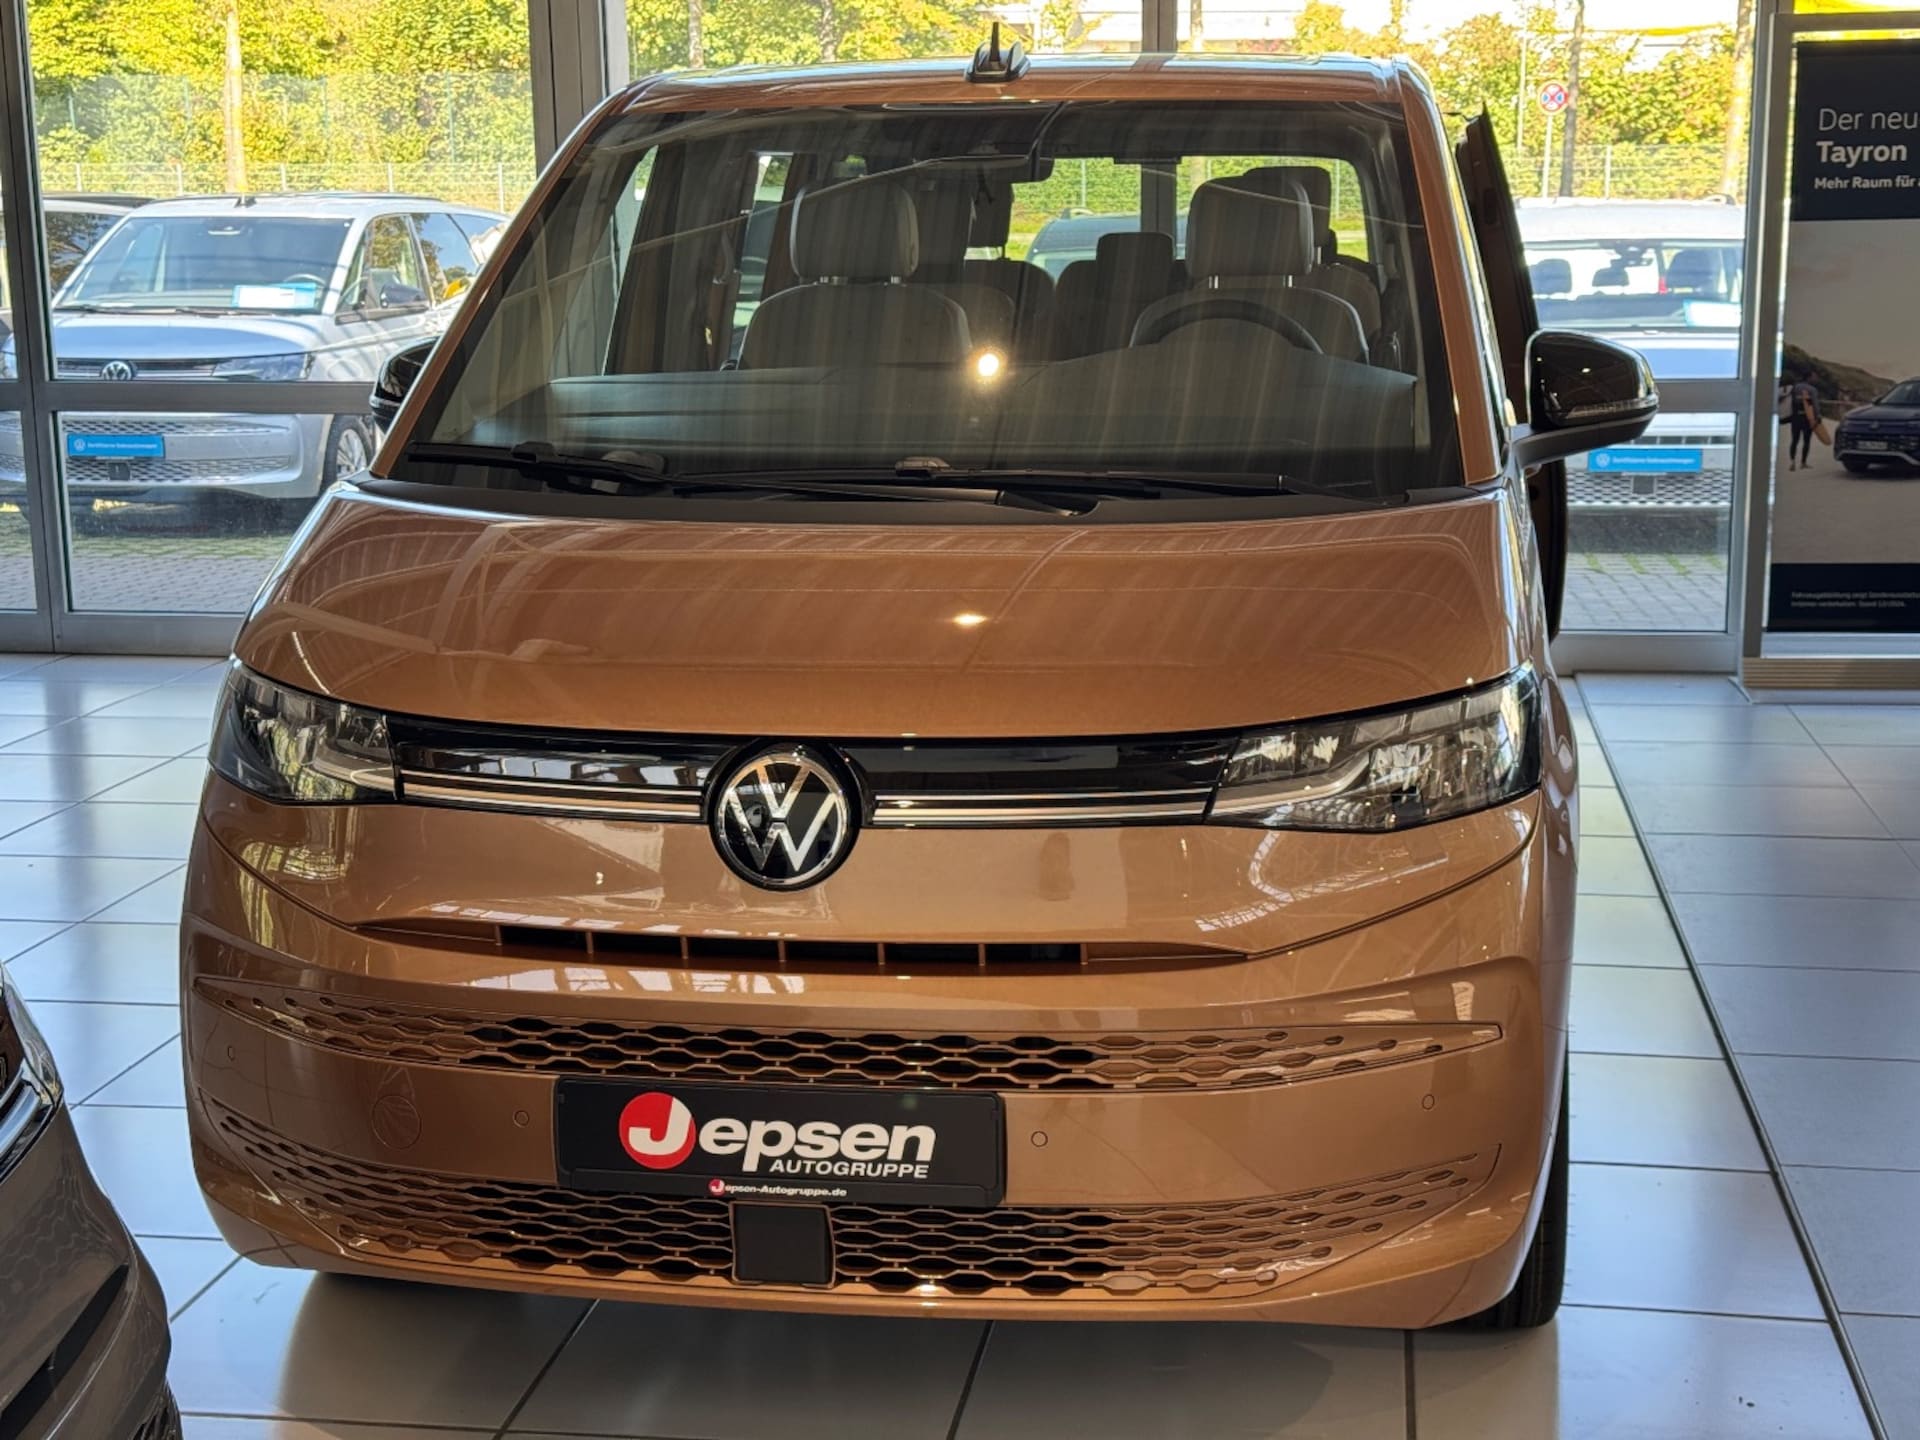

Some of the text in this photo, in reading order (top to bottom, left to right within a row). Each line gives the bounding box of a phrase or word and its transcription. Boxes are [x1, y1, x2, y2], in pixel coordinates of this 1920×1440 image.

[1819, 108, 1920, 131] Der neu
[1816, 141, 1908, 168] Tayron
[1814, 177, 1850, 189] Mehr
[1852, 176, 1892, 189] Raum
[1896, 175, 1915, 188] für
[723, 760, 841, 872] VW
[627, 1095, 937, 1173] Jepsen
[769, 1159, 930, 1180] AUTOGRUPPE
[709, 1179, 848, 1198] Jepsen-Autogruppe.de
